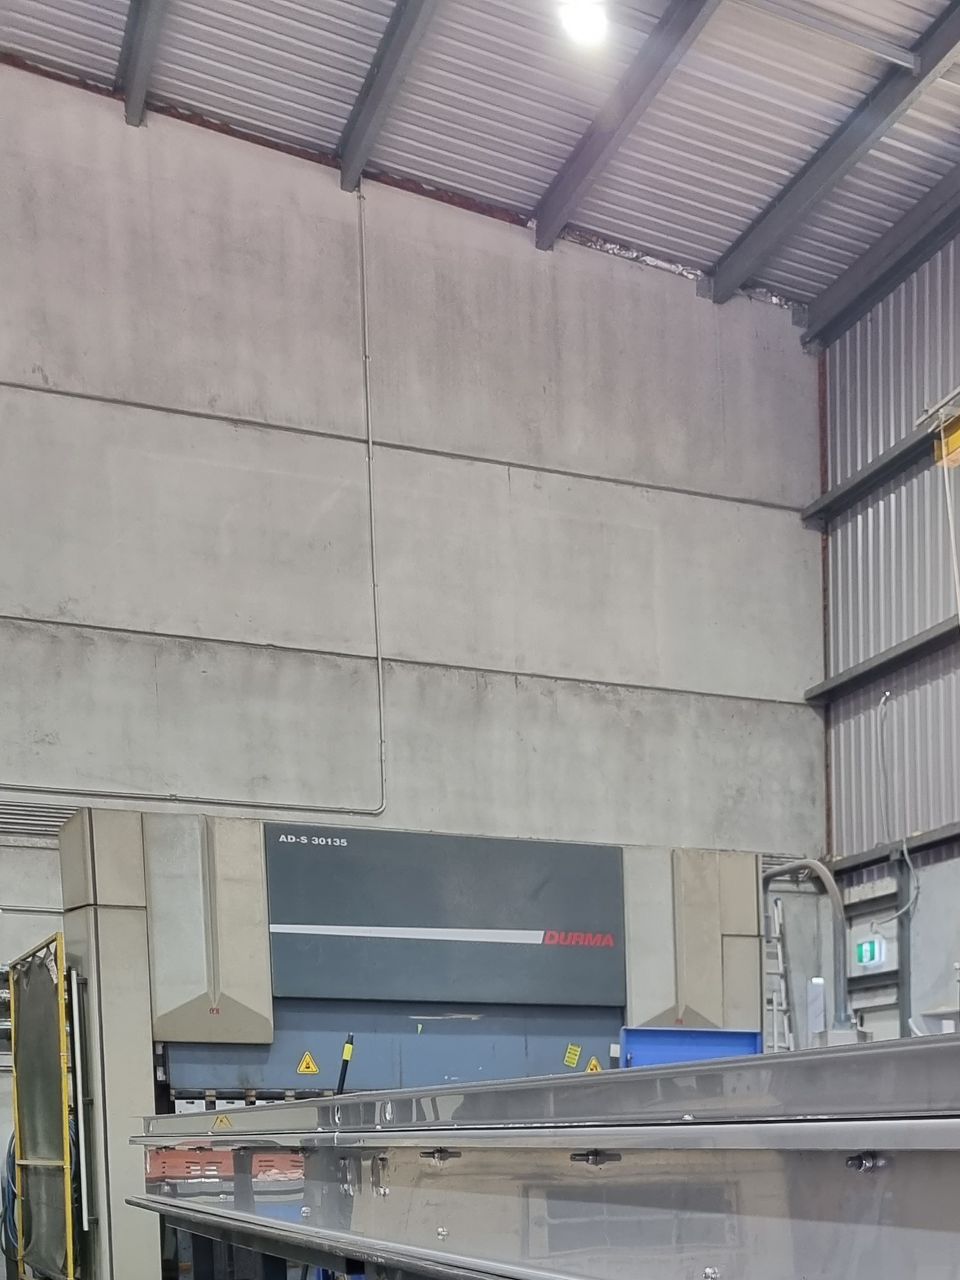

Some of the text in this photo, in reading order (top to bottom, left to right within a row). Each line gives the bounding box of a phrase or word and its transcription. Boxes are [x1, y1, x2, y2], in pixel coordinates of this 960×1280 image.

[279, 834, 348, 847] AD-S 30135
[544, 930, 615, 946] DURMA
